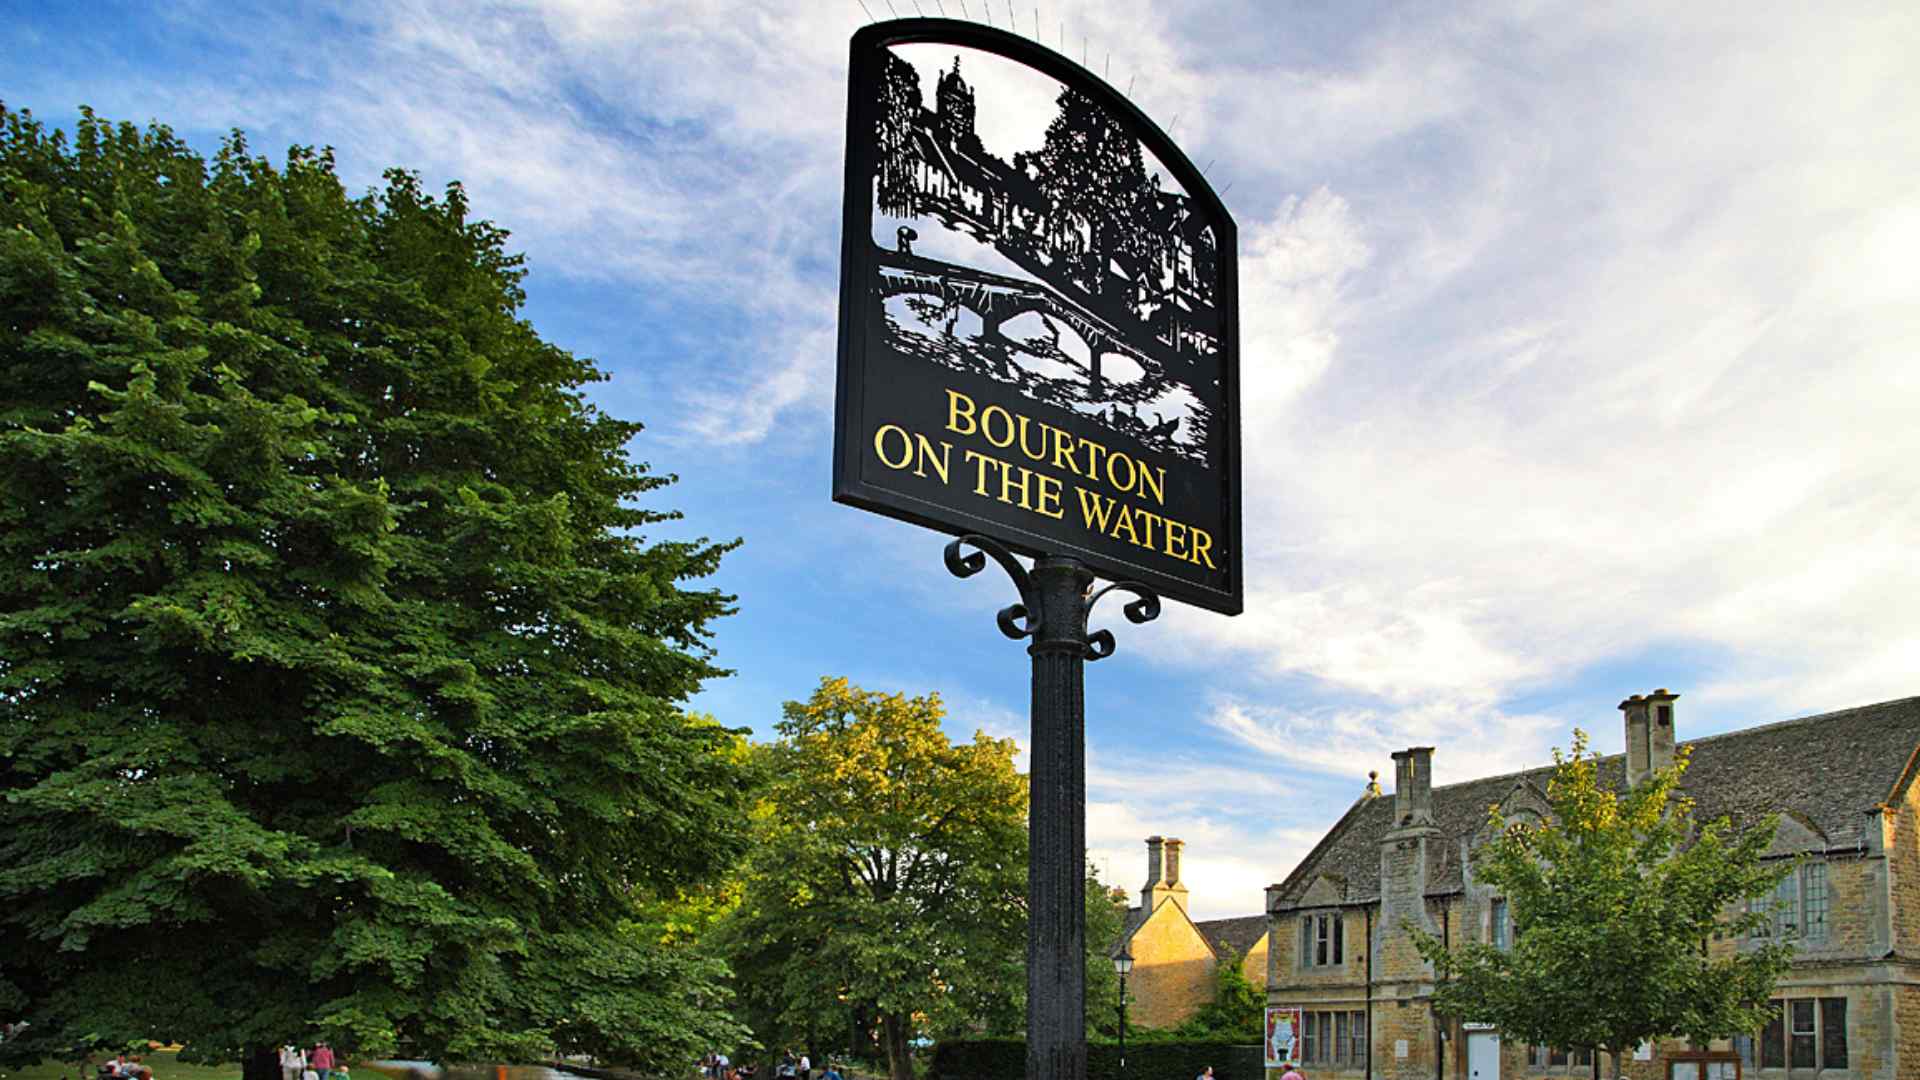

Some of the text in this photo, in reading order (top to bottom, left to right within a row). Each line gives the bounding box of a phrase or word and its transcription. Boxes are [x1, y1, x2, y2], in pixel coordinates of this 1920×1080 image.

[874, 424, 1216, 569] ON THE WATER
[945, 389, 1166, 505] BOURTON
